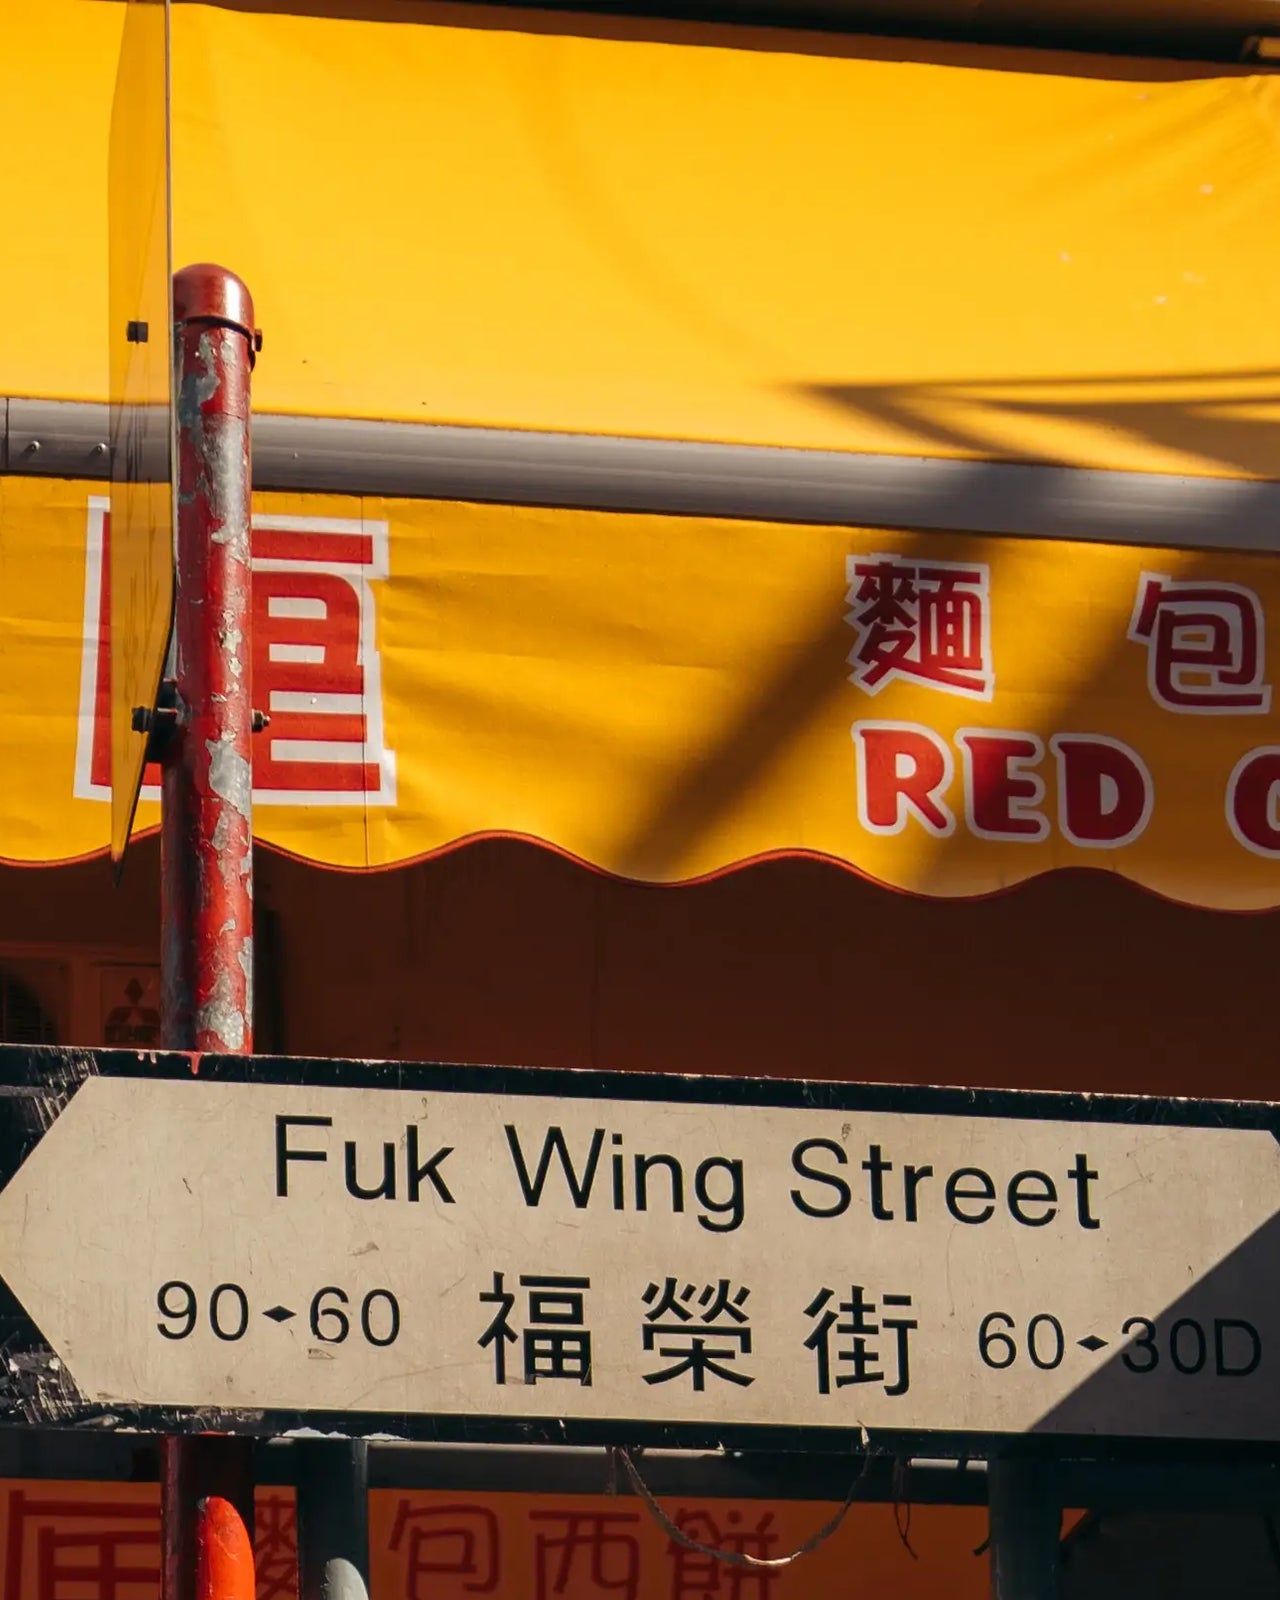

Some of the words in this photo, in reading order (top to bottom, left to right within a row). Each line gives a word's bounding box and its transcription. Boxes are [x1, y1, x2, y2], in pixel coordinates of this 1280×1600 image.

[851, 719, 1154, 849] RED
[274, 1115, 457, 1204] Fuk
[504, 1124, 746, 1234] Wing
[789, 1136, 1102, 1230] Street
[477, 1270, 918, 1397] 福榮街
